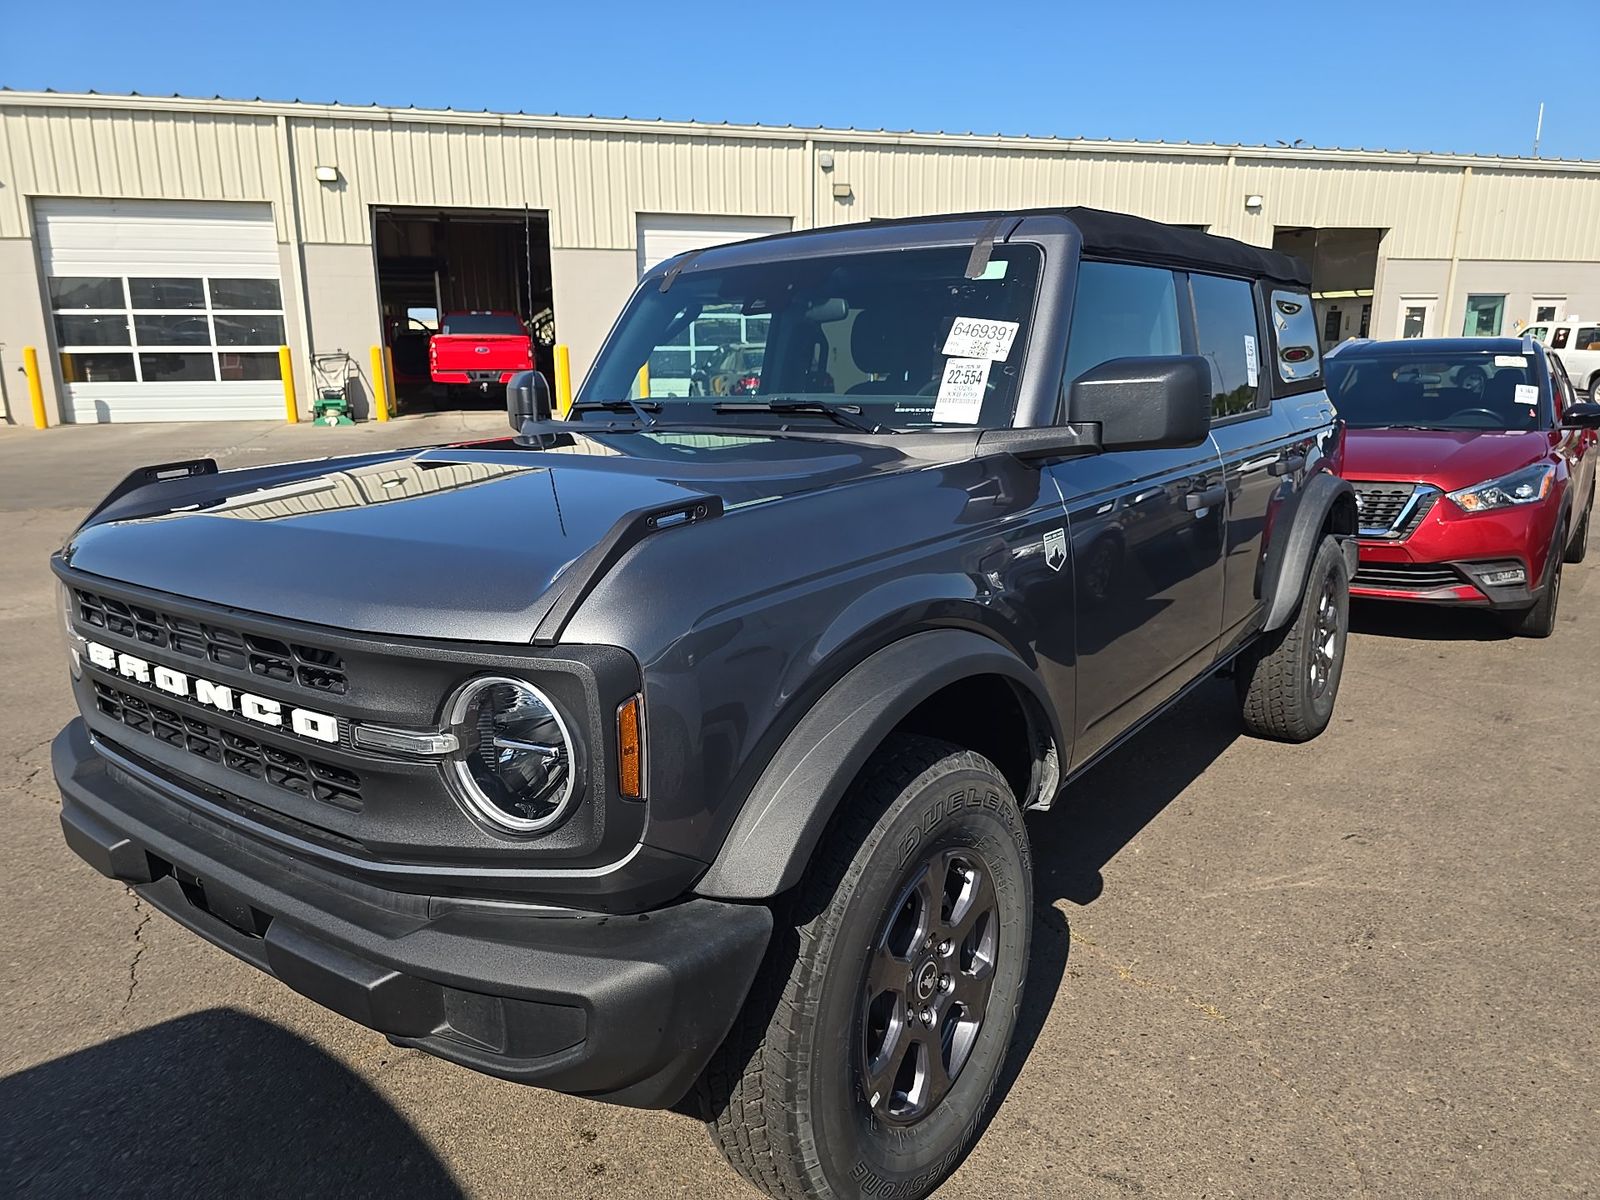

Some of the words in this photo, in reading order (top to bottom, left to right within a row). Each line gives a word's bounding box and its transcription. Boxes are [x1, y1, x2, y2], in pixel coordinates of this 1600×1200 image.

[953, 321, 1015, 342] 6469391
[946, 369, 983, 385] 22:554
[87, 641, 340, 744] BRONCO
[898, 788, 1015, 870] DUELER
